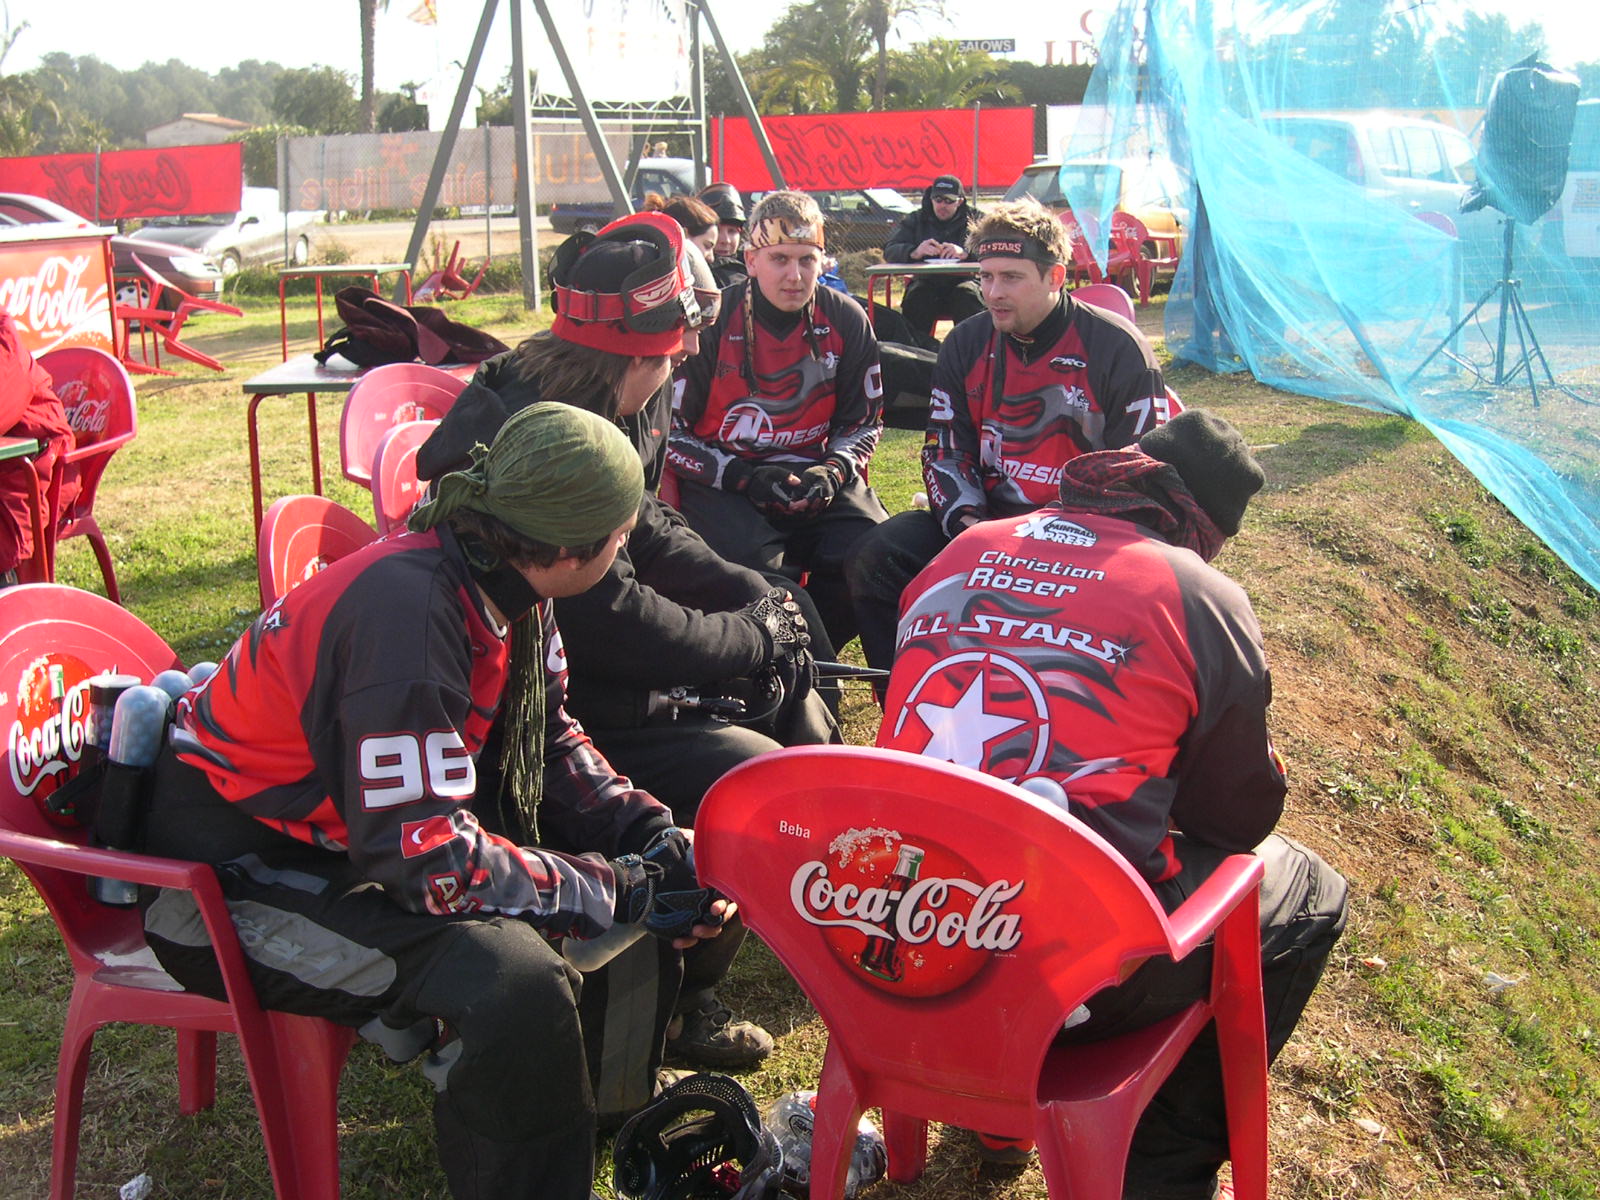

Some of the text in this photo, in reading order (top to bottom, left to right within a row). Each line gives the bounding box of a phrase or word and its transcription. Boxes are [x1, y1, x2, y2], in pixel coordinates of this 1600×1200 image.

[967, 566, 1078, 598] Röser
[978, 550, 1106, 581] Christian
[900, 614, 1123, 665] ALL STARS
[360, 731, 477, 809] 96
[779, 820, 811, 840] Beba
[790, 860, 1025, 951] Coca-Cola
